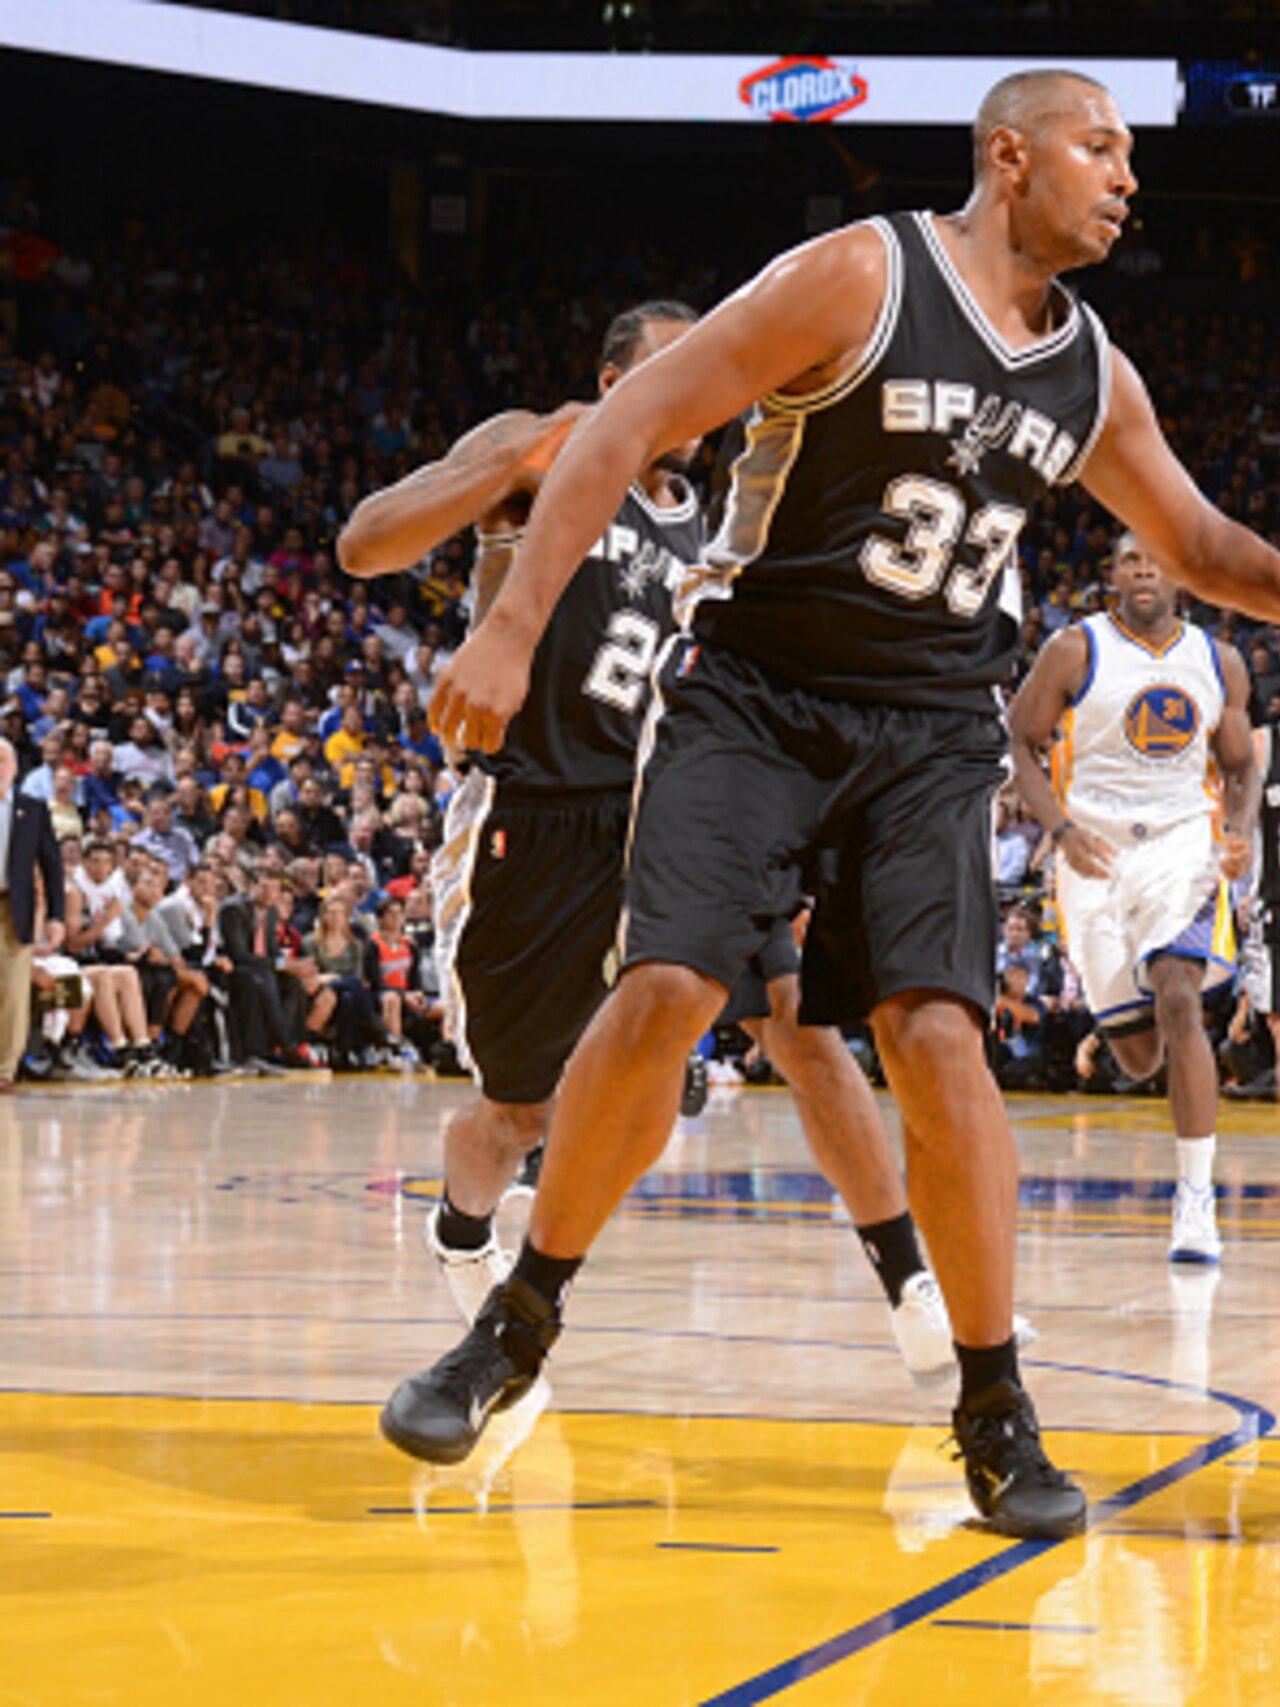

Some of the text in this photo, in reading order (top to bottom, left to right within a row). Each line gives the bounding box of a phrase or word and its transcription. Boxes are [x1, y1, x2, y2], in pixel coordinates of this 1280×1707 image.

[752, 70, 855, 112] CLOROX
[1247, 84, 1277, 110] TF
[857, 473, 1028, 619] 33
[582, 607, 661, 714] 2
